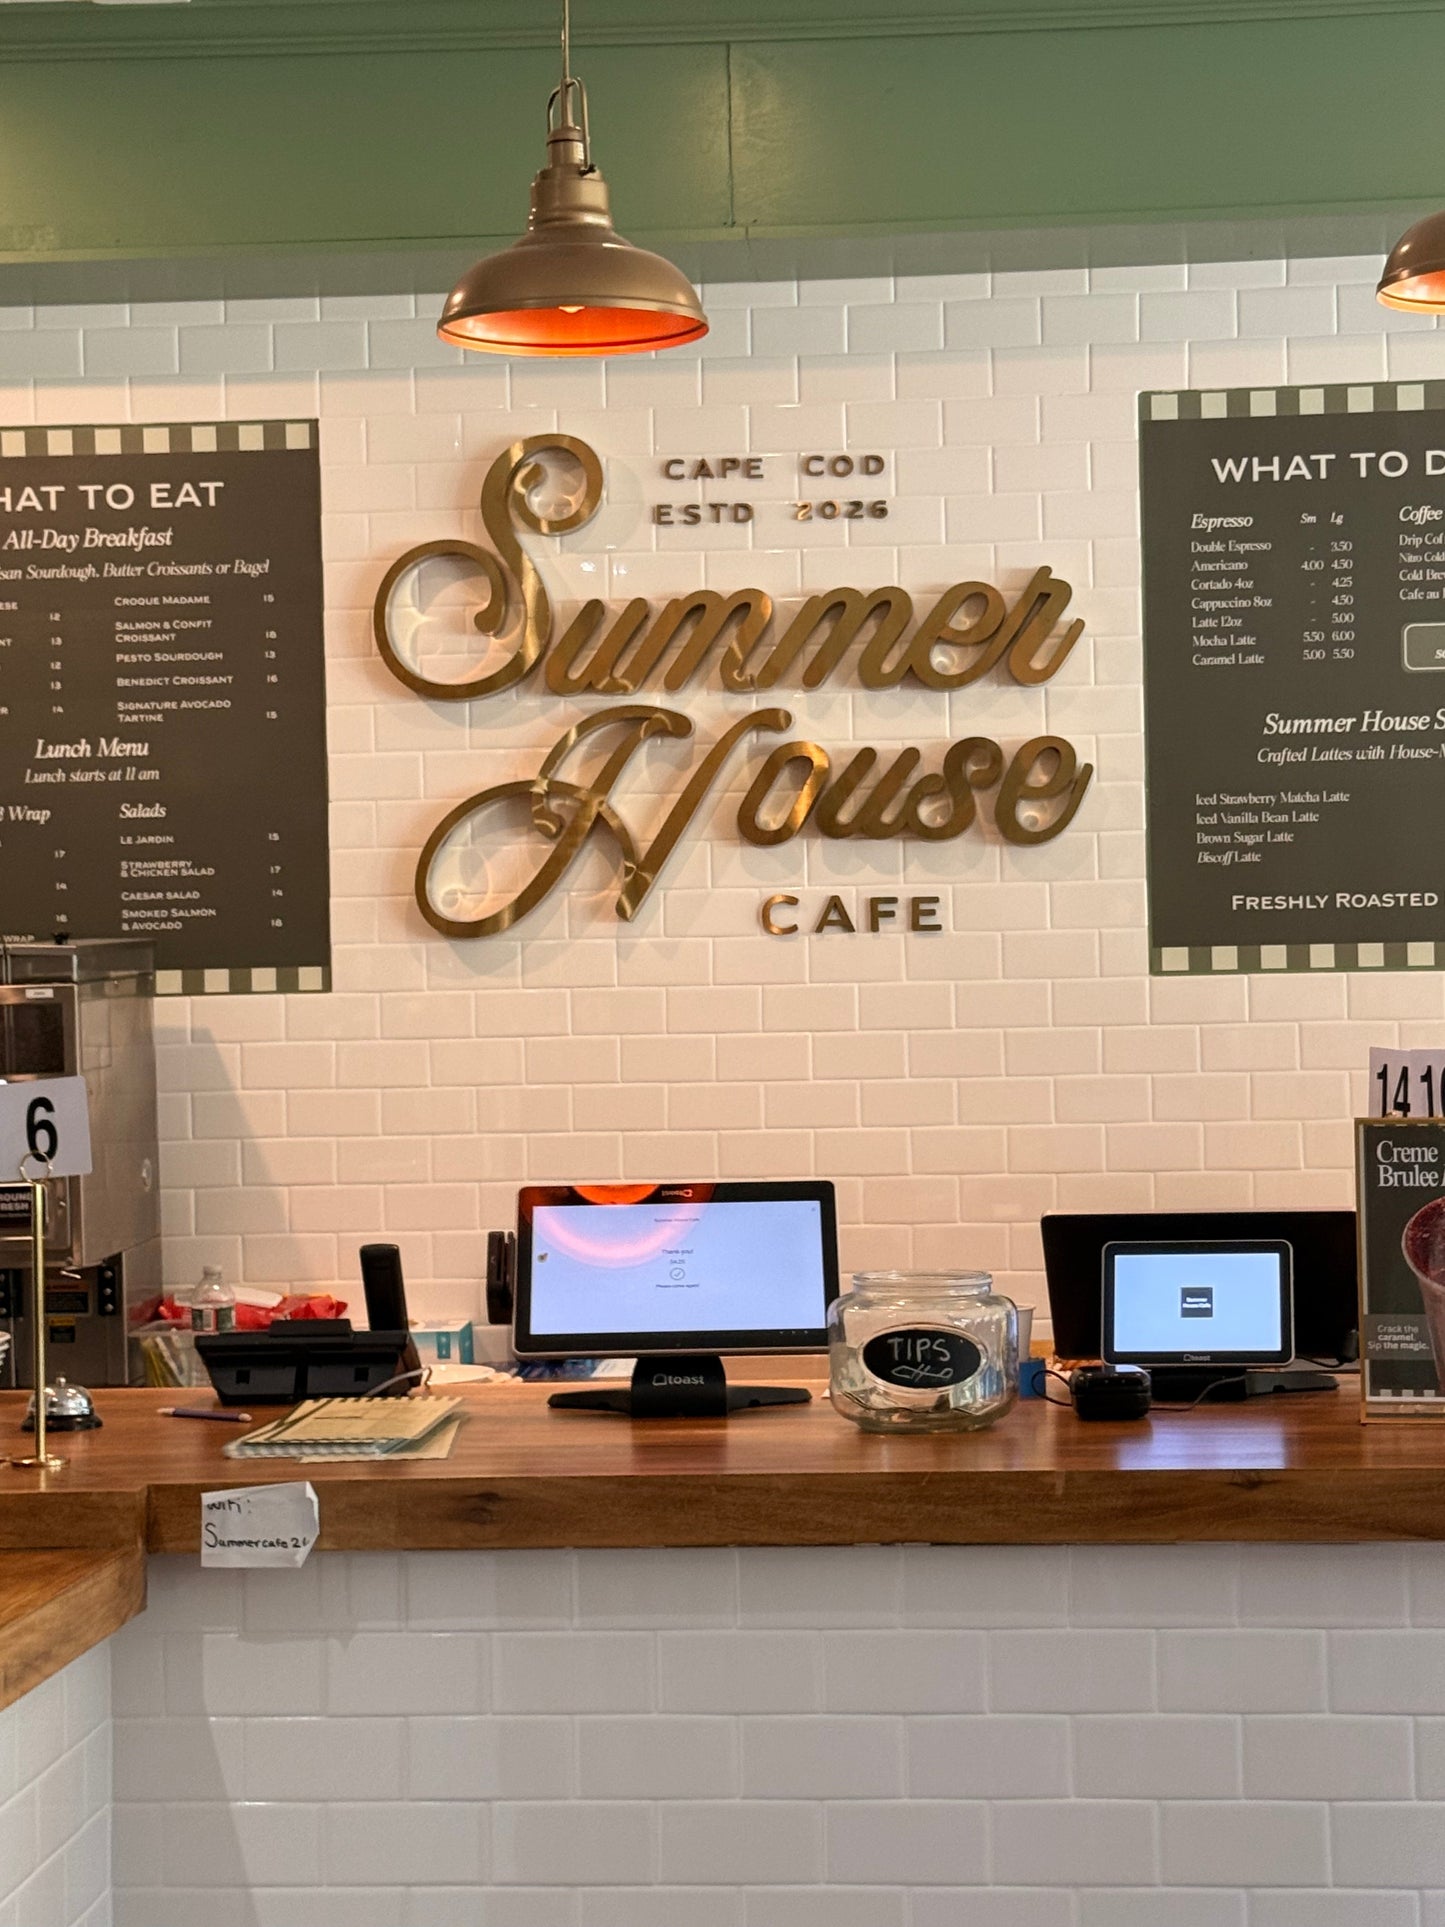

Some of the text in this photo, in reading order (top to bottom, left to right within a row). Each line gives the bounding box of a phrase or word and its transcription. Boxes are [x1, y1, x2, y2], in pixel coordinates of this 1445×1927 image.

[664, 453, 885, 481] CAPE COD
[1211, 454, 1336, 483] WHAT
[1350, 451, 1408, 477] TO
[78, 484, 134, 509] TO
[151, 482, 224, 508] EAT
[655, 499, 889, 526] ESTD 2026
[1301, 512, 1343, 525] Sm Lg
[1399, 506, 1443, 525] Coffee
[1191, 514, 1253, 532] Espresso
[3, 527, 173, 553] All-Day Breakfast
[1191, 540, 1271, 554] Double Espresso
[1400, 534, 1422, 548] Drip
[1400, 553, 1422, 563] Nitro
[103, 563, 144, 577] Butter
[147, 562, 212, 576] Croissants
[216, 564, 231, 574] or
[234, 559, 269, 577] Bagel
[373, 433, 1085, 700] Summer
[1192, 560, 1248, 571] Americano
[1399, 570, 1423, 581] Cold
[1191, 578, 1253, 590] Cortado 4oz
[114, 596, 210, 606] CROQUE MADAME
[1400, 588, 1424, 600] Cafe
[1192, 596, 1272, 611] Cappuccino 8oz
[115, 620, 212, 630] SALMON & CONFIT
[1193, 617, 1218, 628] Latte
[116, 633, 175, 642] CROISSANT
[1193, 634, 1256, 646] Mocha Latte
[116, 652, 223, 662] PESTO SOURDOUGH
[1193, 653, 1264, 665] Caramel Latte
[117, 676, 233, 686] BENEDICT CROISSANT
[117, 700, 231, 710] SIGNATURE AVOCADO
[118, 714, 163, 722] TARTINE
[1264, 713, 1356, 734] Summer
[1360, 711, 1430, 731] House
[35, 738, 148, 758] Lunch Menu
[1258, 748, 1307, 766] Crafted
[1311, 747, 1352, 761] Lattes
[1356, 746, 1384, 760] with
[25, 769, 65, 783] Lunch
[70, 770, 105, 781] starts
[108, 769, 122, 781] at
[138, 770, 159, 780] am
[1196, 791, 1350, 806] Iced Strawberry Matcha Latte
[9, 806, 50, 824] Wrap
[119, 803, 166, 818] Salads
[1197, 811, 1319, 824] Iced Vanilla Bean Latte
[415, 704, 1093, 938] House
[120, 836, 174, 844] LE JARDIN
[1197, 831, 1294, 845] Brown Sugar Latte
[119, 860, 194, 870] STRAWBERRY
[1198, 851, 1261, 865] Biscoff Latte
[120, 867, 216, 878] & CHICKEN SALAD
[121, 891, 200, 900] CAESAR SALAD
[1233, 893, 1438, 910] FRESHLY ROASTED
[122, 908, 216, 918] SMOKED SALMON
[762, 893, 943, 936] CAFE
[132, 921, 182, 930] AVOCADO
[1376, 1063, 1445, 1117] 14 1
[26, 1096, 58, 1163] 6
[1376, 1140, 1438, 1163] Creme
[1377, 1165, 1439, 1187] Brulee
[1377, 1325, 1419, 1333] Crack the
[888, 1338, 951, 1363] TIPS
[1368, 1341, 1382, 1351] Sip
[1400, 1341, 1430, 1351] magic.
[668, 1375, 704, 1385] toast
